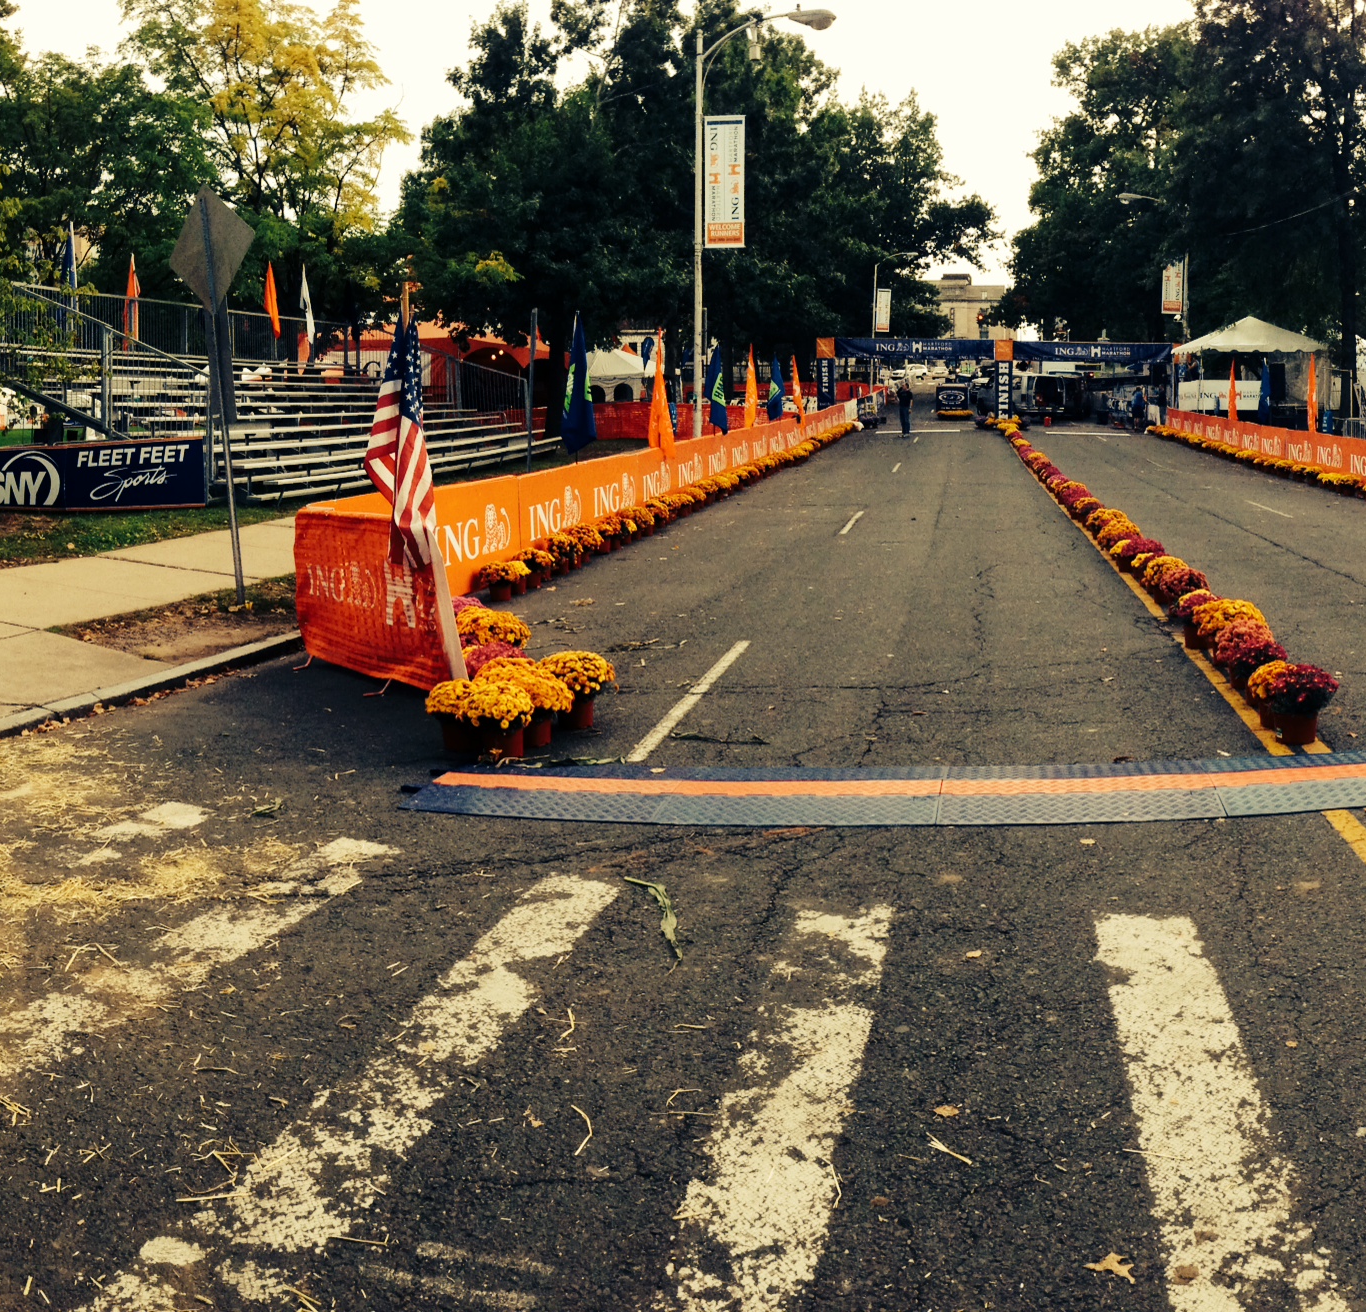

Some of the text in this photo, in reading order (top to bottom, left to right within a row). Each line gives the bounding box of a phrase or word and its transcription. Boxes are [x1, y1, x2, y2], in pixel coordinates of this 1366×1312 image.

[876, 343, 895, 352] ING
[1054, 347, 1074, 356] ING
[998, 362, 1009, 419] FINISH
[1243, 434, 1254, 450] ING
[1261, 438, 1274, 456] ING
[1288, 443, 1302, 462] ING
[77, 445, 190, 467] FLEET FEET
[708, 452, 721, 477] ING
[732, 446, 743, 468] ING
[1317, 445, 1331, 467] ING
[89, 465, 178, 503] Sports
[643, 471, 660, 502] ING
[678, 461, 693, 489] ING
[594, 482, 620, 518] ING
[529, 498, 562, 541] ING
[306, 562, 345, 602] ING
